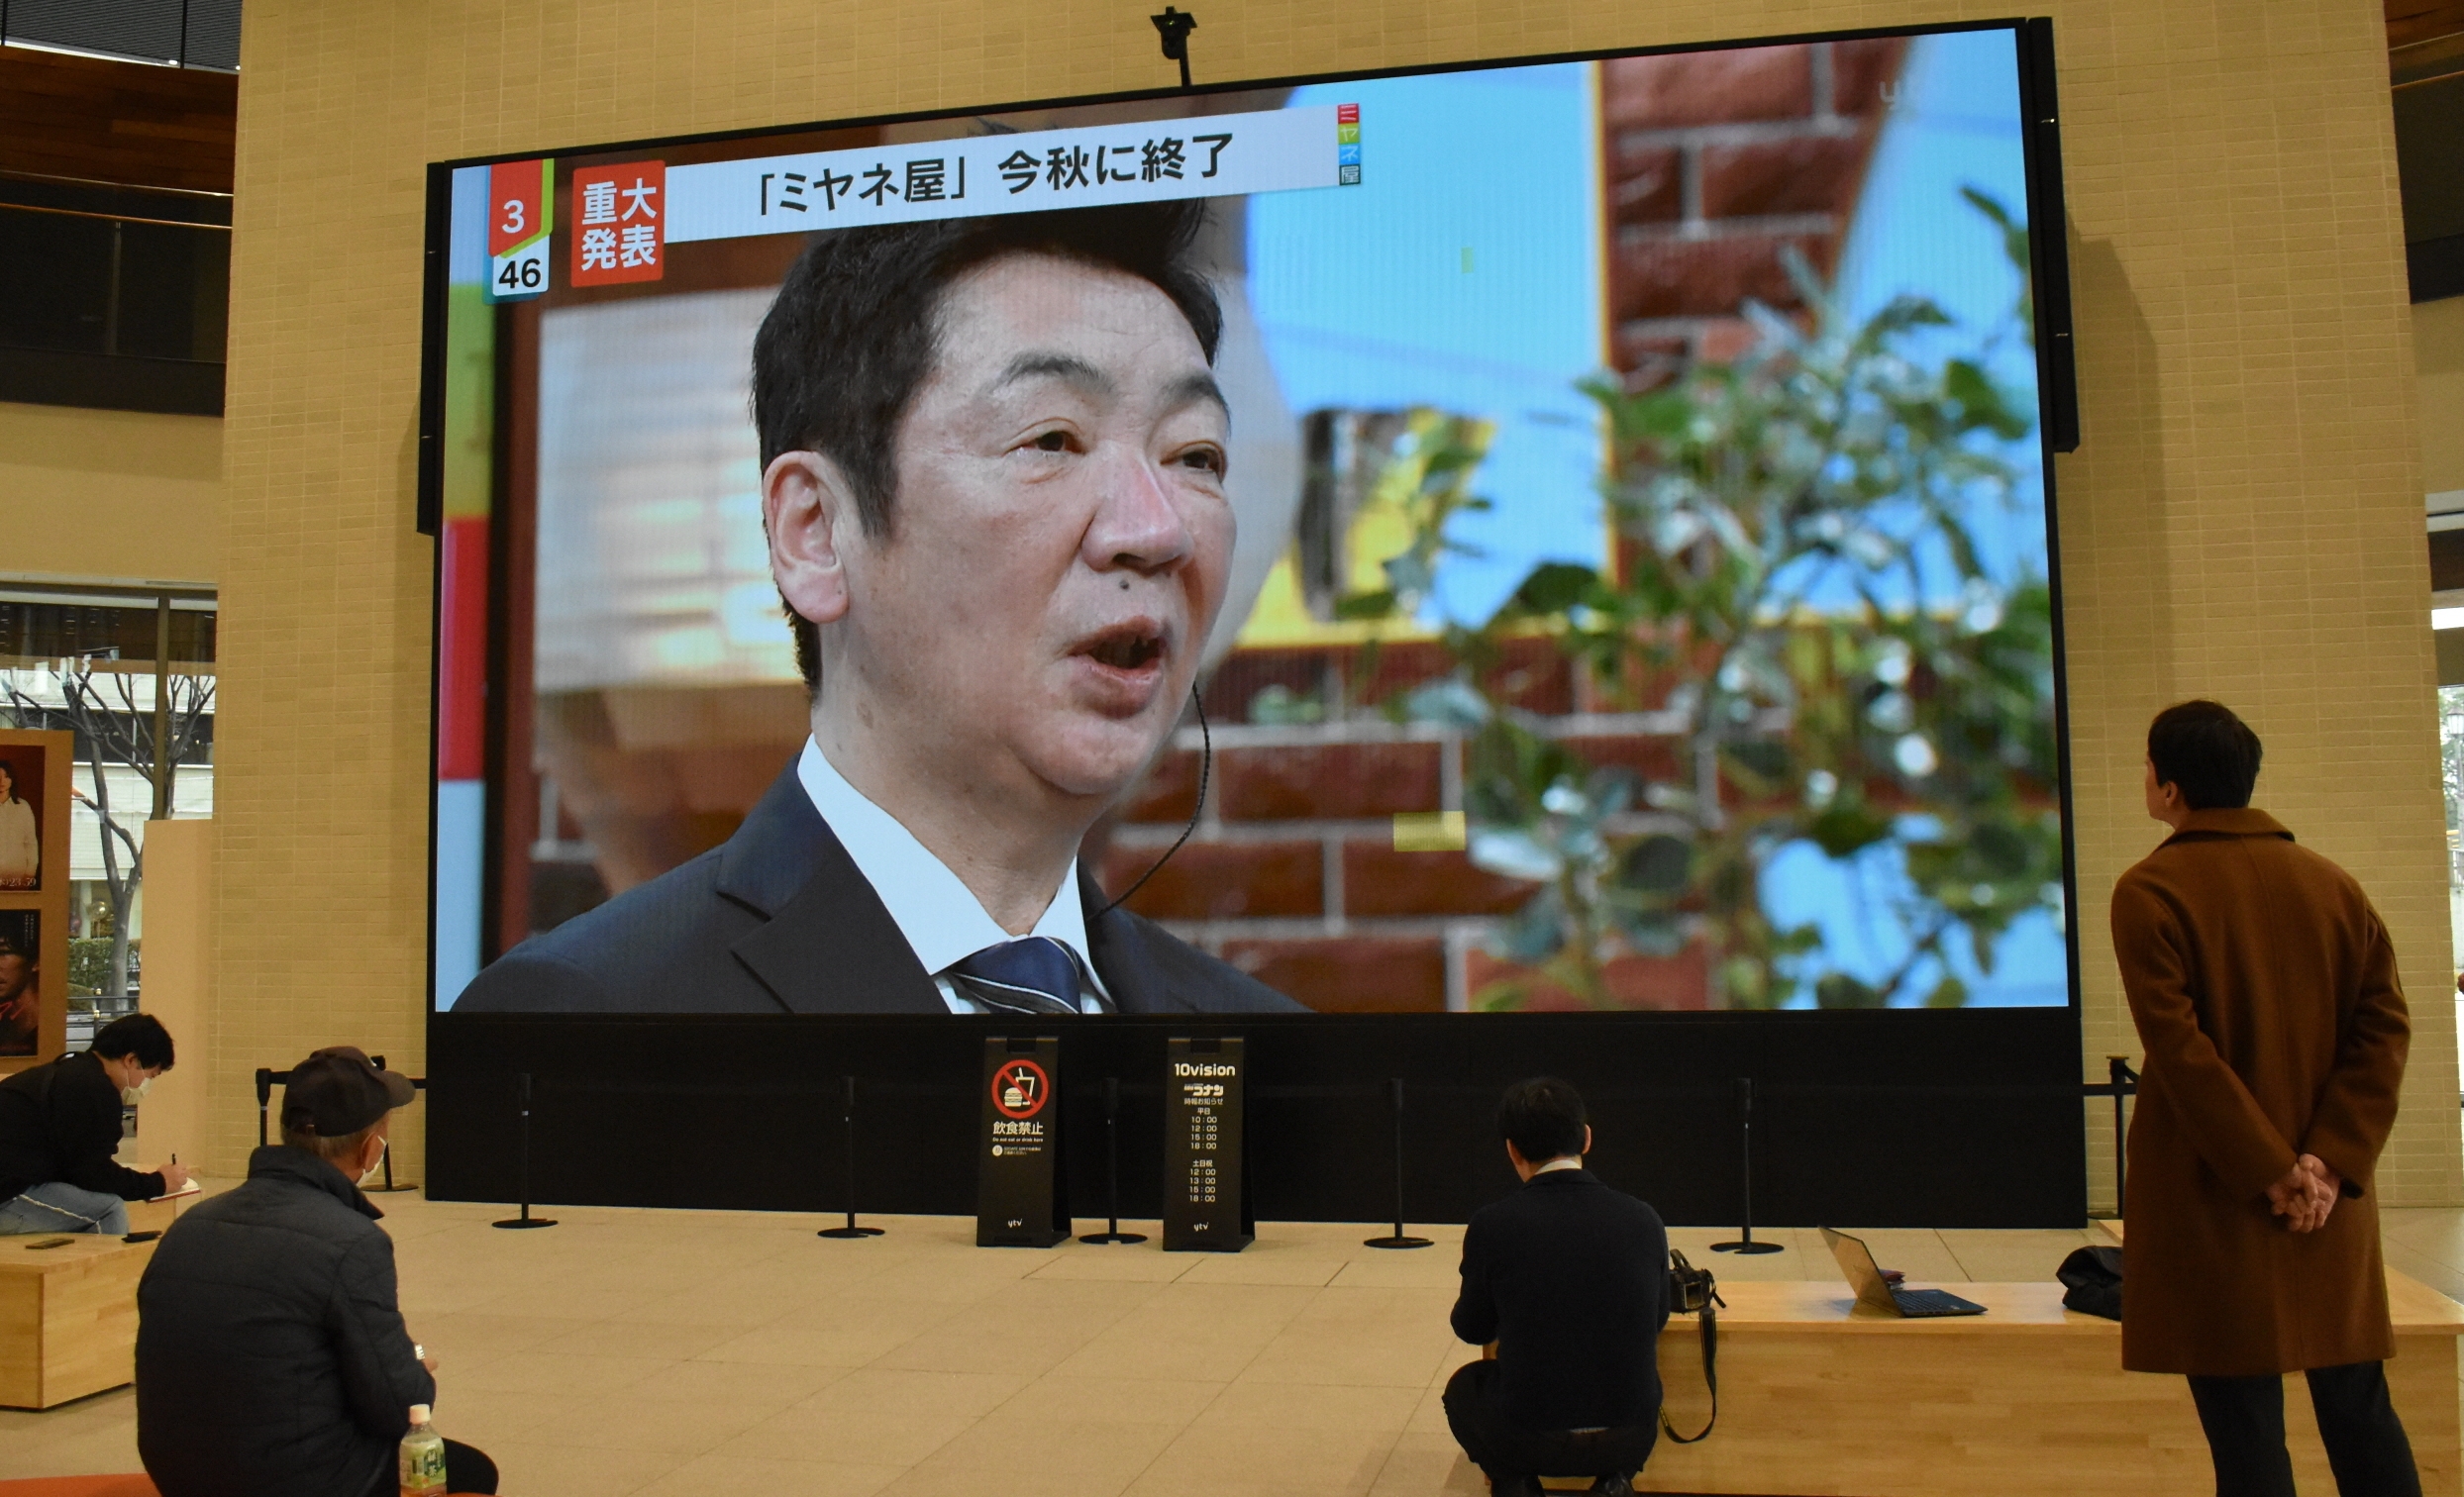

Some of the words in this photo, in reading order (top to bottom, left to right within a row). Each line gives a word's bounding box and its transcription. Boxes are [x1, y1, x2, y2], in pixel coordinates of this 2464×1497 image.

[1339, 104, 1360, 184] ミヤネ屋
[761, 156, 966, 215] 「ミヤネ屋」
[997, 133, 1233, 194] 今秋に終了
[501, 200, 524, 234] 3
[581, 178, 657, 226] 重大
[580, 224, 657, 271] 発表
[498, 258, 542, 290] 46
[1175, 1063, 1236, 1076] 10vision
[992, 1121, 1044, 1136] 飲食禁止
[1007, 1218, 1023, 1229] ytv
[1193, 1221, 1209, 1232] ytv
